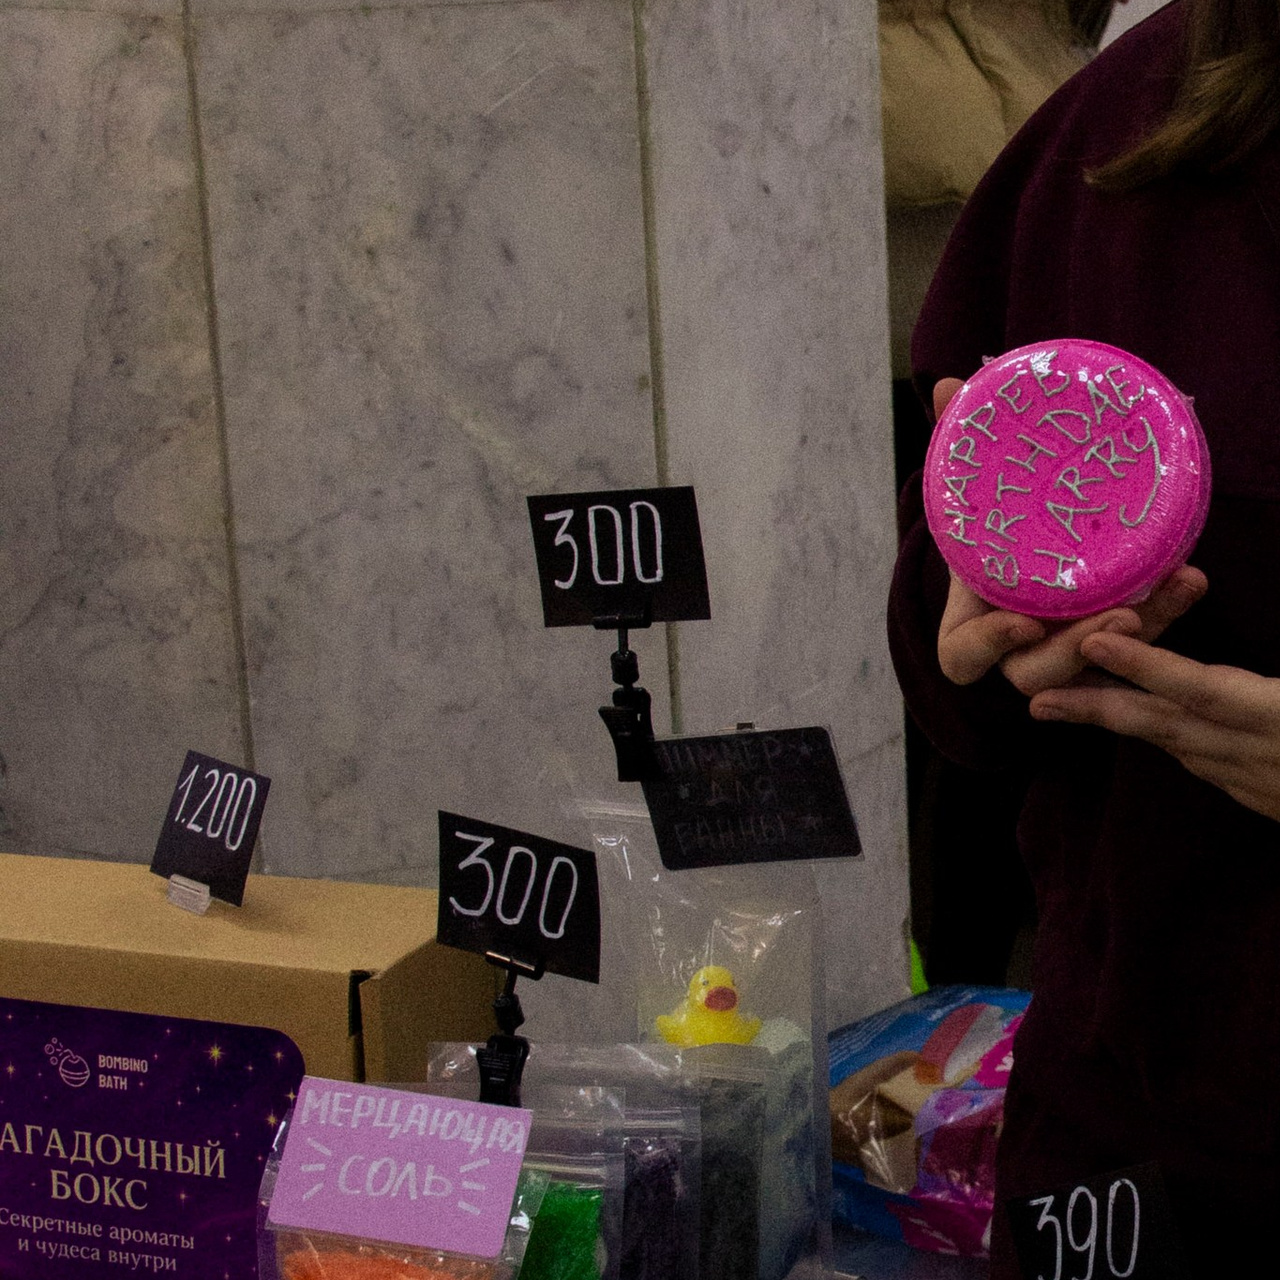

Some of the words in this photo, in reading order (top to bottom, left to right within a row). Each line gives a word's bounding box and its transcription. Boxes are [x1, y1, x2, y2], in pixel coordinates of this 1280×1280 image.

[544, 501, 664, 590] 300
[449, 831, 578, 939] 300
[98, 1054, 149, 1073] BOMBINO
[98, 1074, 128, 1091] BATH
[299, 1088, 526, 1155] МЕРЦАЮЩАЯ
[50, 1169, 149, 1211] БОКС
[337, 1155, 453, 1200] СОЛЬ
[0, 1207, 103, 1238] Секретные
[109, 1225, 195, 1250] ароматы
[17, 1237, 30, 1252] и
[35, 1239, 101, 1259] чудеса
[108, 1249, 177, 1273] внутри
